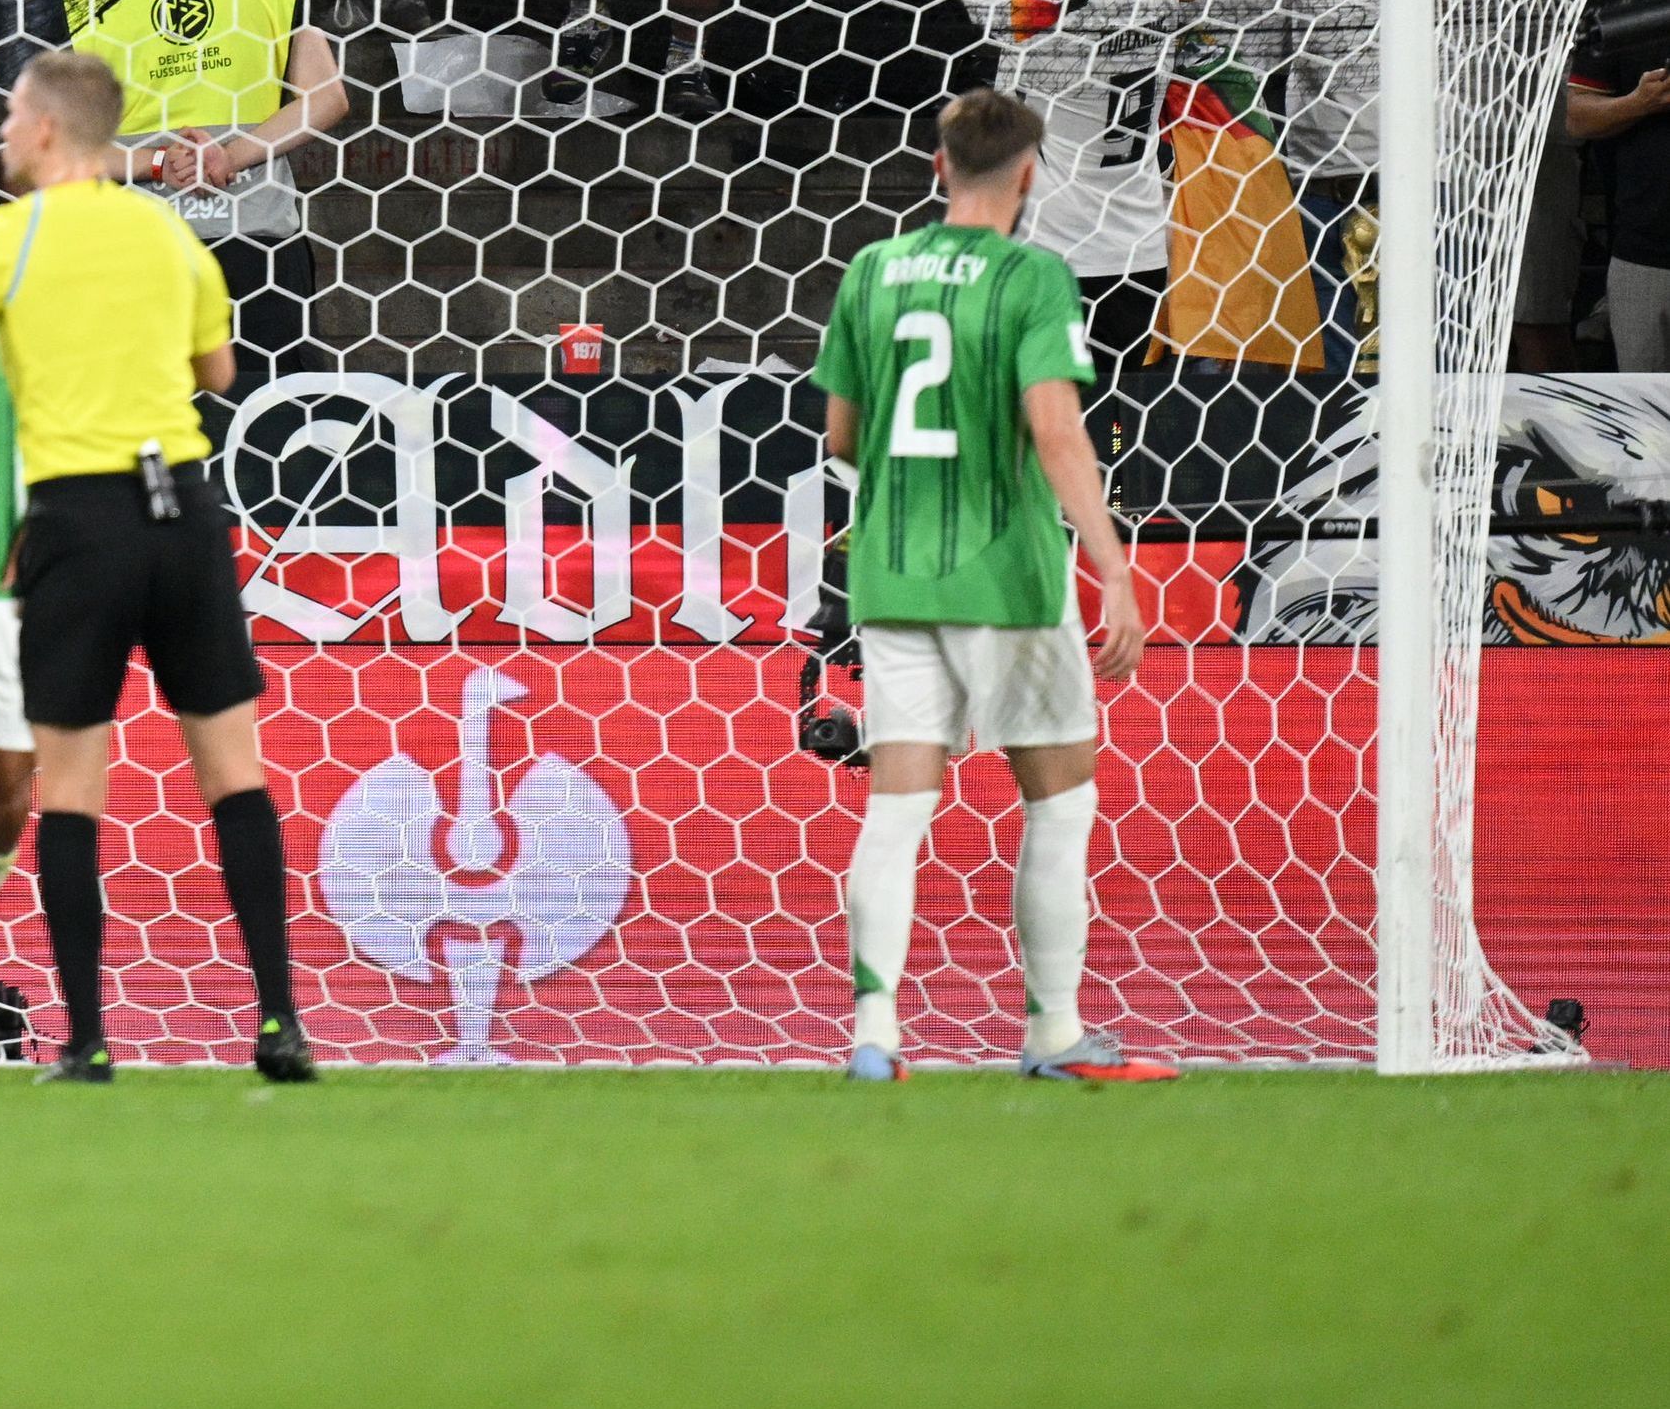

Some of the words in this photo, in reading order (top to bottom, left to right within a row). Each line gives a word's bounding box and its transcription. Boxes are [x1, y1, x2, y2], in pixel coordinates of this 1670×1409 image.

[148, 60, 198, 80] FUSSBALL
[201, 56, 232, 72] BUND
[157, 46, 220, 66] DEUTSCHER
[888, 311, 958, 458] 2
